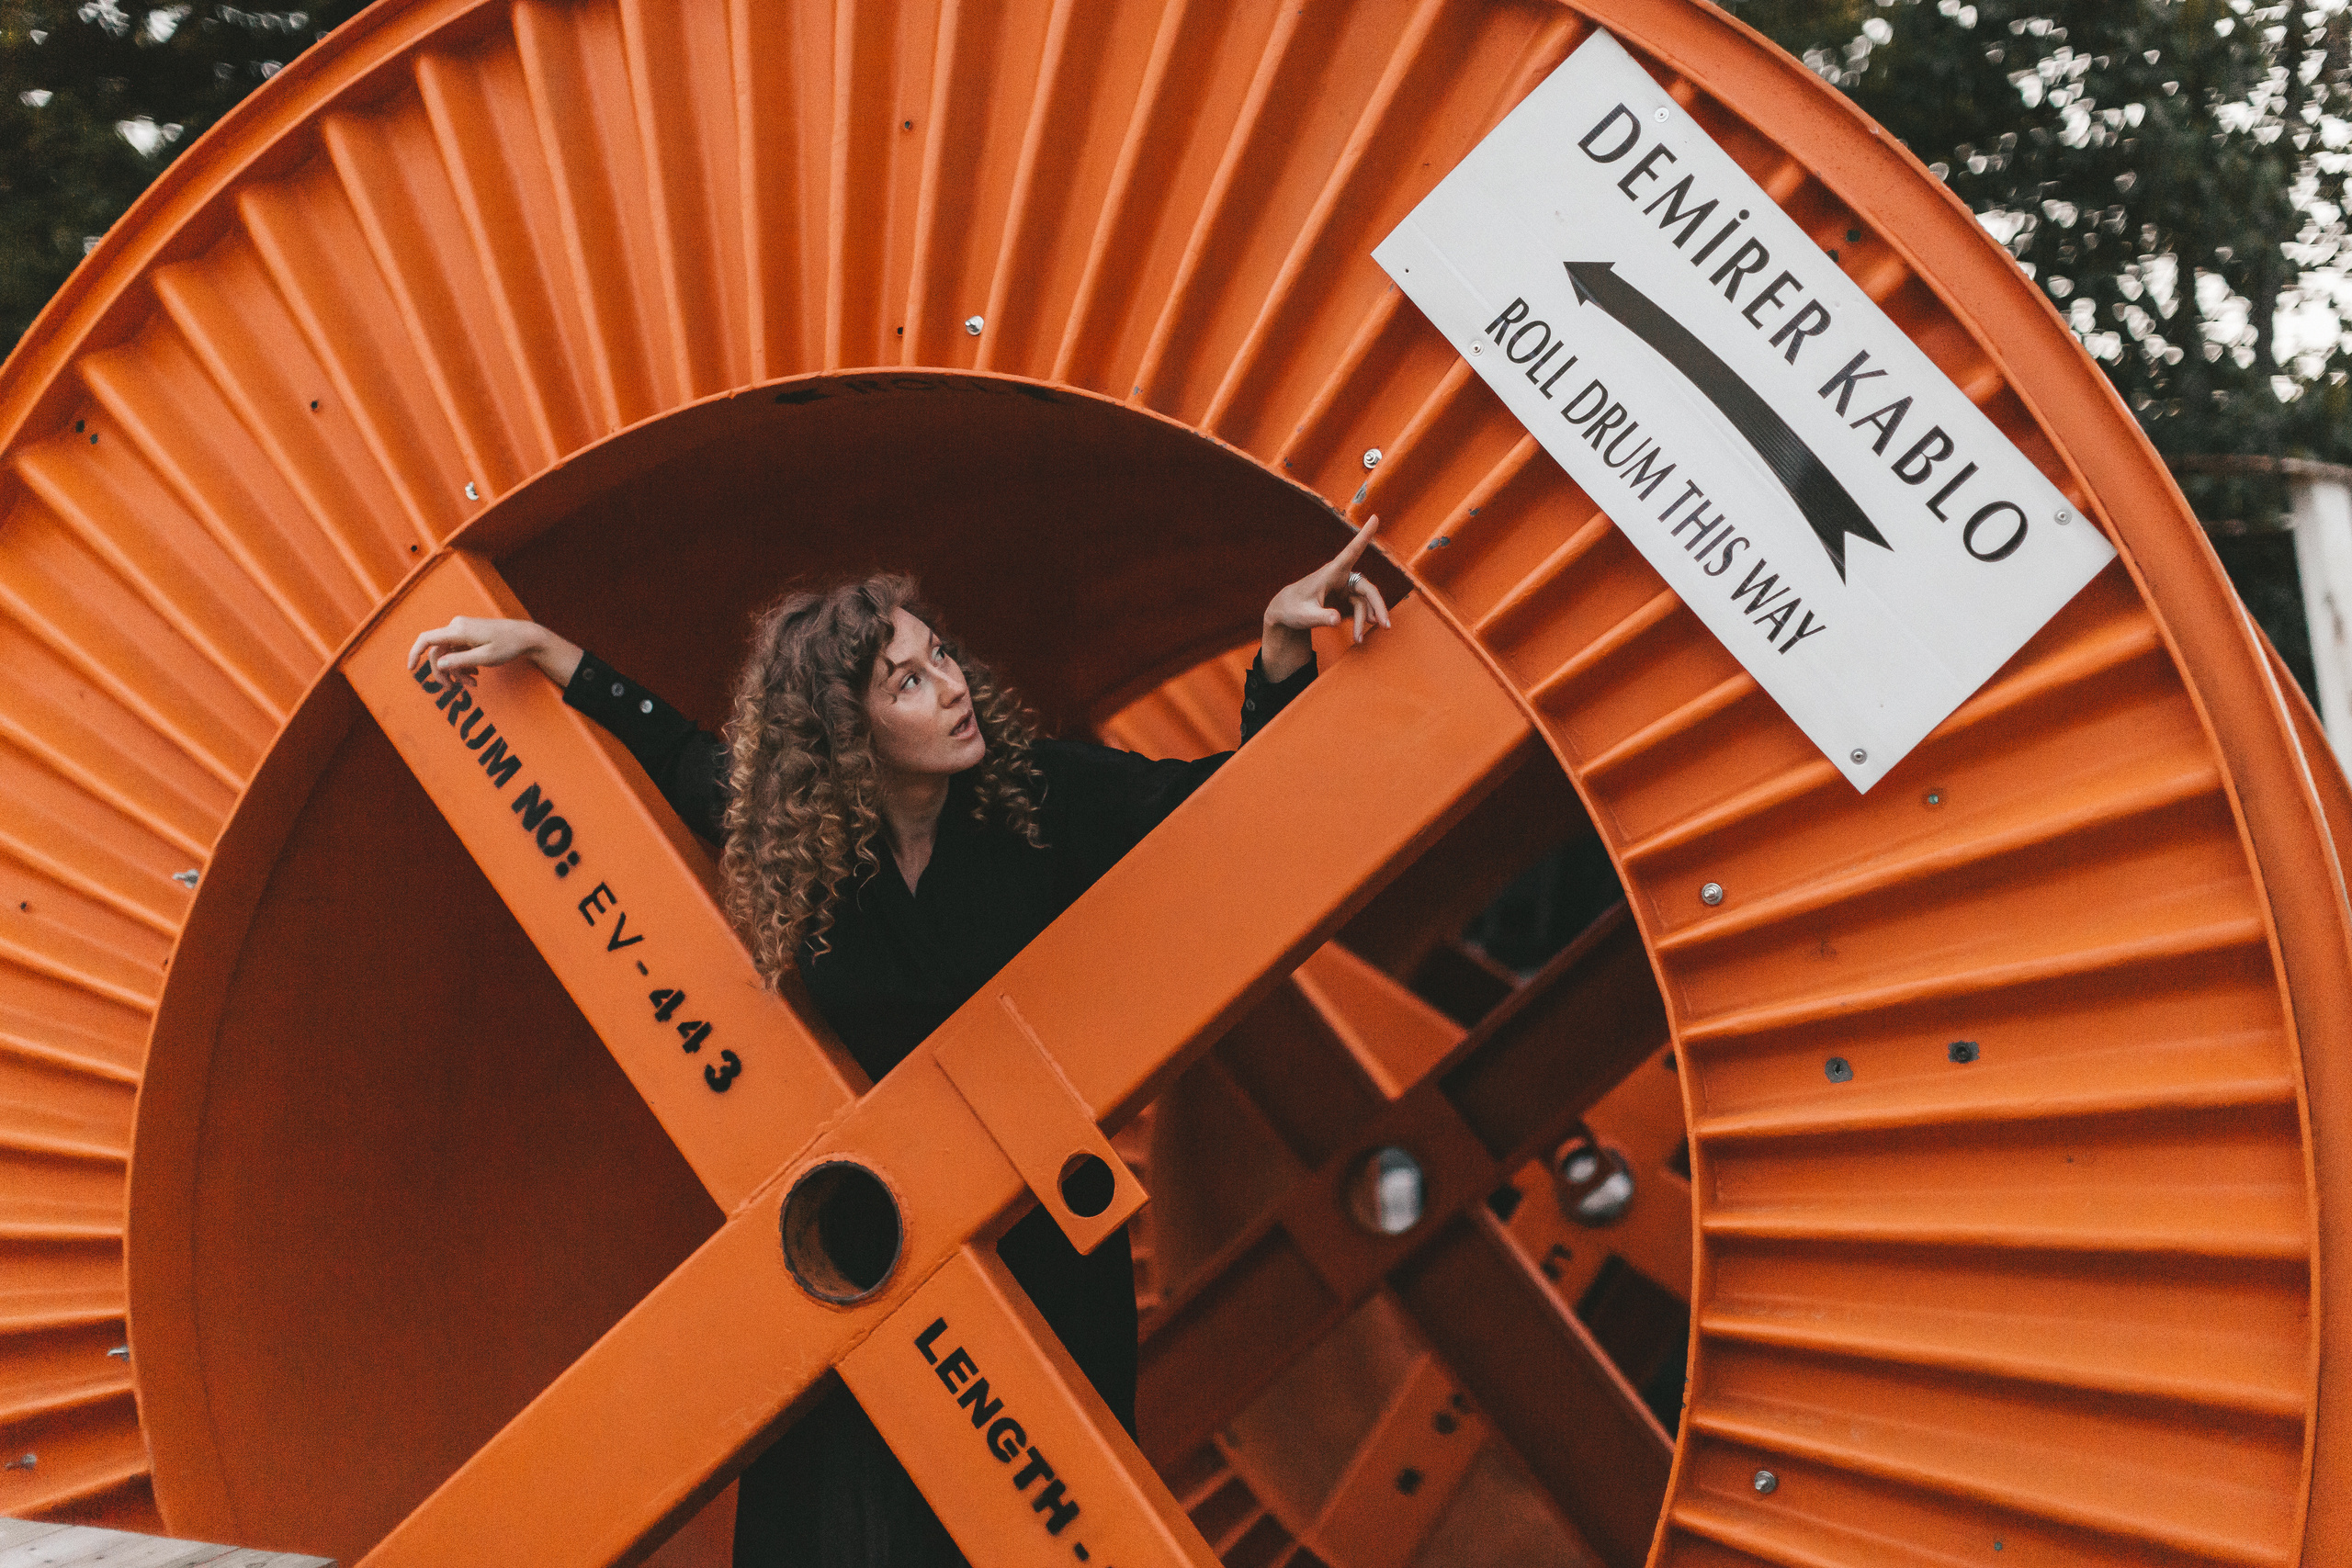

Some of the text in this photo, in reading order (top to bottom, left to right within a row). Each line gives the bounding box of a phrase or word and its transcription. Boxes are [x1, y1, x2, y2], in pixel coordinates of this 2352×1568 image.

[1485, 297, 1826, 655] ROLL DRUM THIS WAY
[1817, 350, 2029, 563] KABLO
[512, 783, 581, 878] NO:
[913, 1316, 1080, 1537] LENGTH
